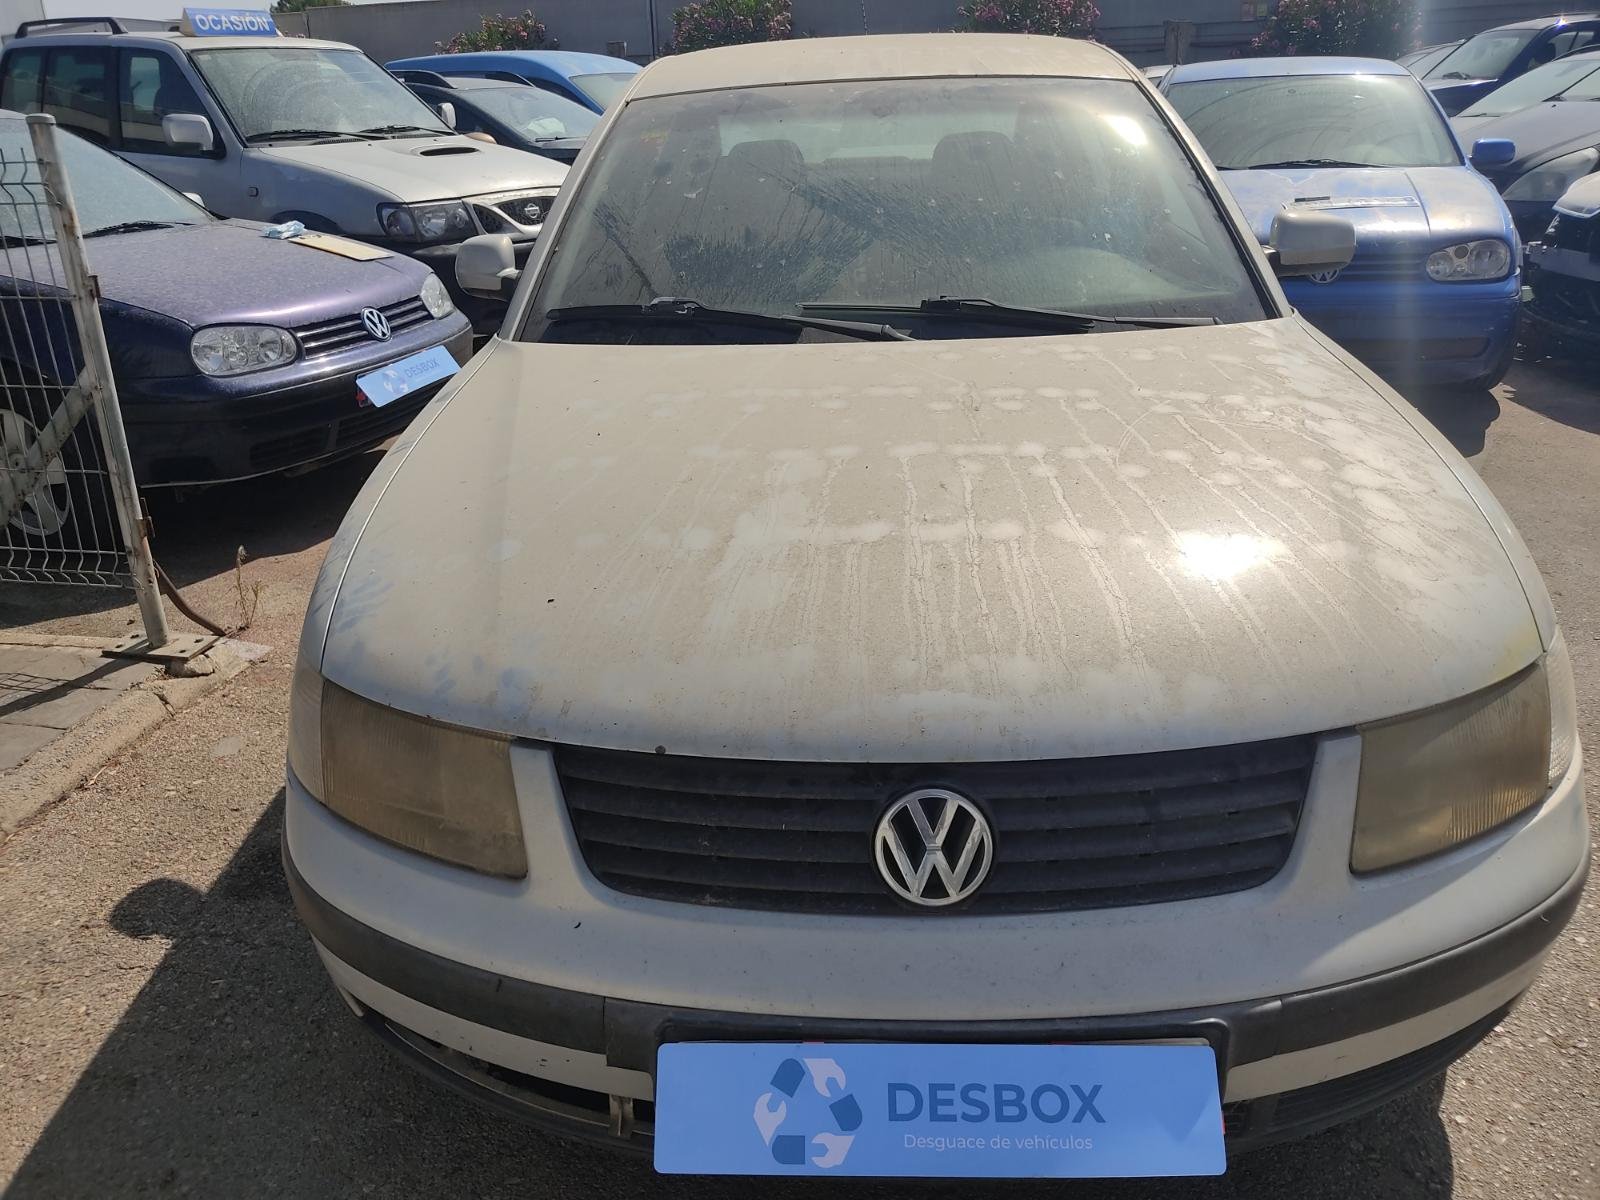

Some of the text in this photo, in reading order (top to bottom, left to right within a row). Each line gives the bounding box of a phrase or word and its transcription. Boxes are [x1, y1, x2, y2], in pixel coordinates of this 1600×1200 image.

[195, 12, 270, 31] OCASIÓN
[364, 309, 390, 339] VW
[404, 358, 440, 378] DESBOX
[876, 790, 992, 905] VW
[887, 1082, 1106, 1124] DESBOX
[904, 1134, 1094, 1151] Desguace de vehículos
